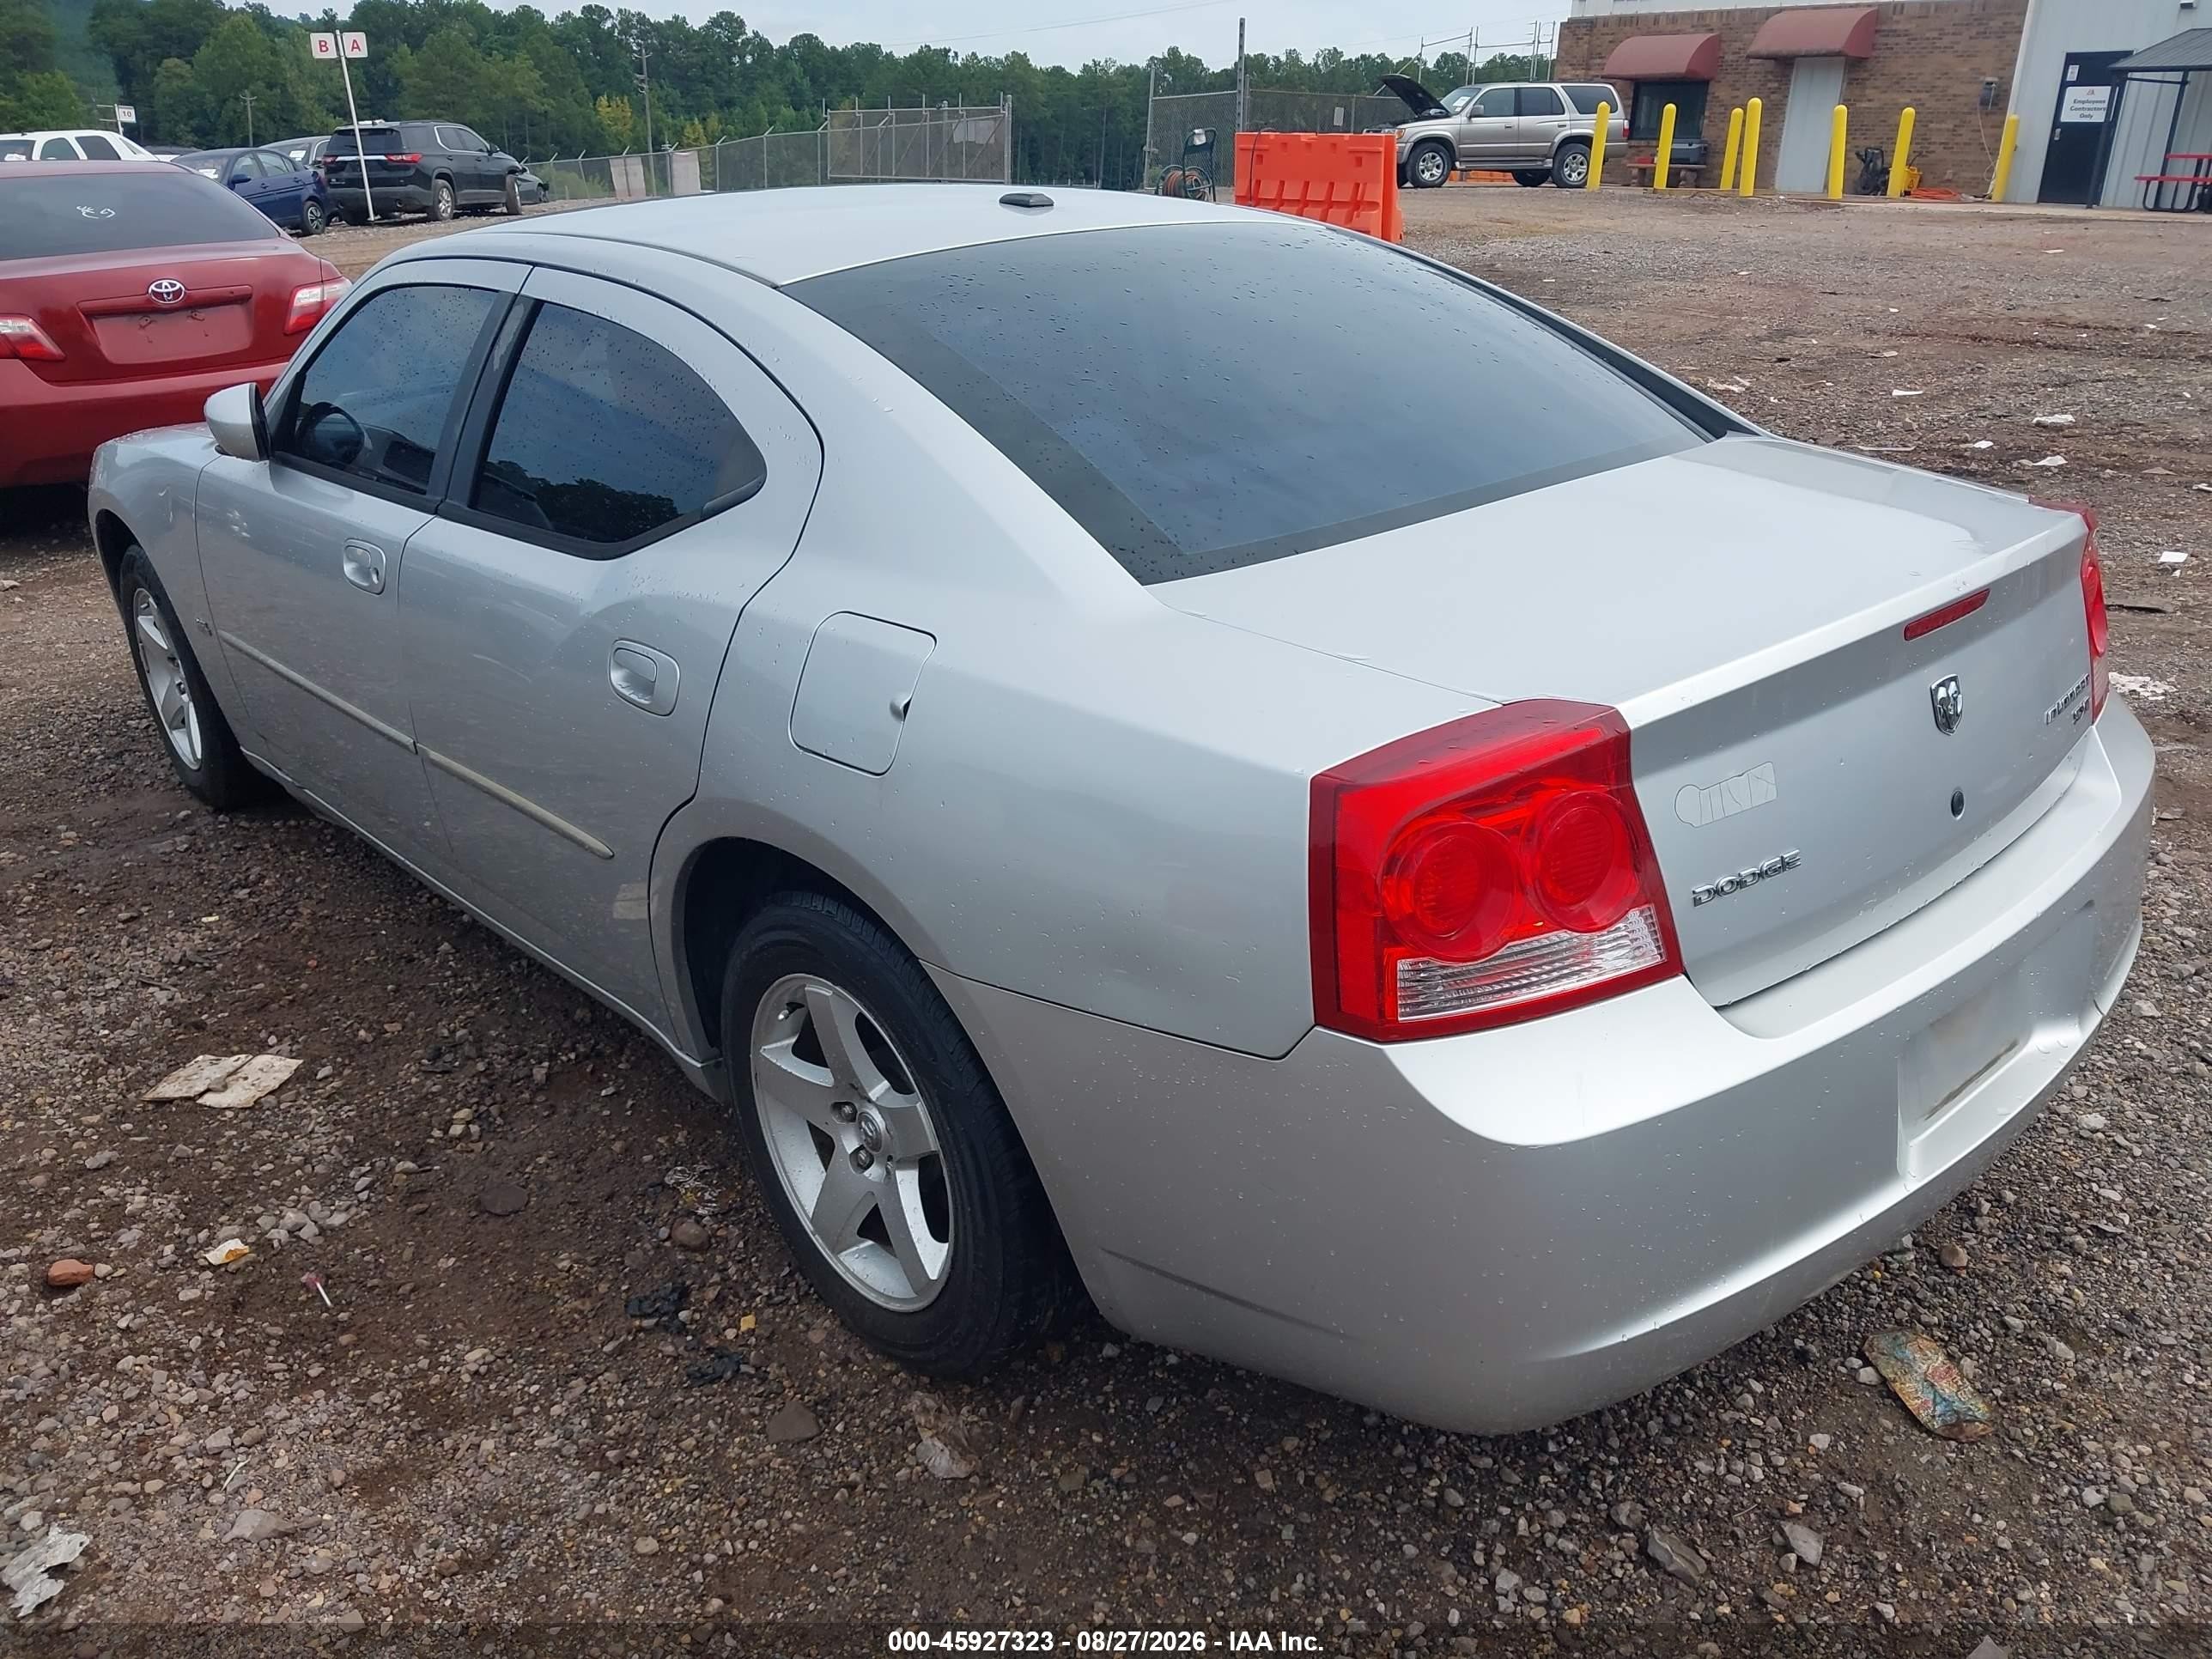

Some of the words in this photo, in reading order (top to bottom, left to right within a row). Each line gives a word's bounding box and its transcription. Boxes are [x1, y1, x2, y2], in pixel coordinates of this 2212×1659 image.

[319, 40, 329, 52] B
[351, 39, 361, 52] A
[1692, 848, 1802, 907] DODGE
